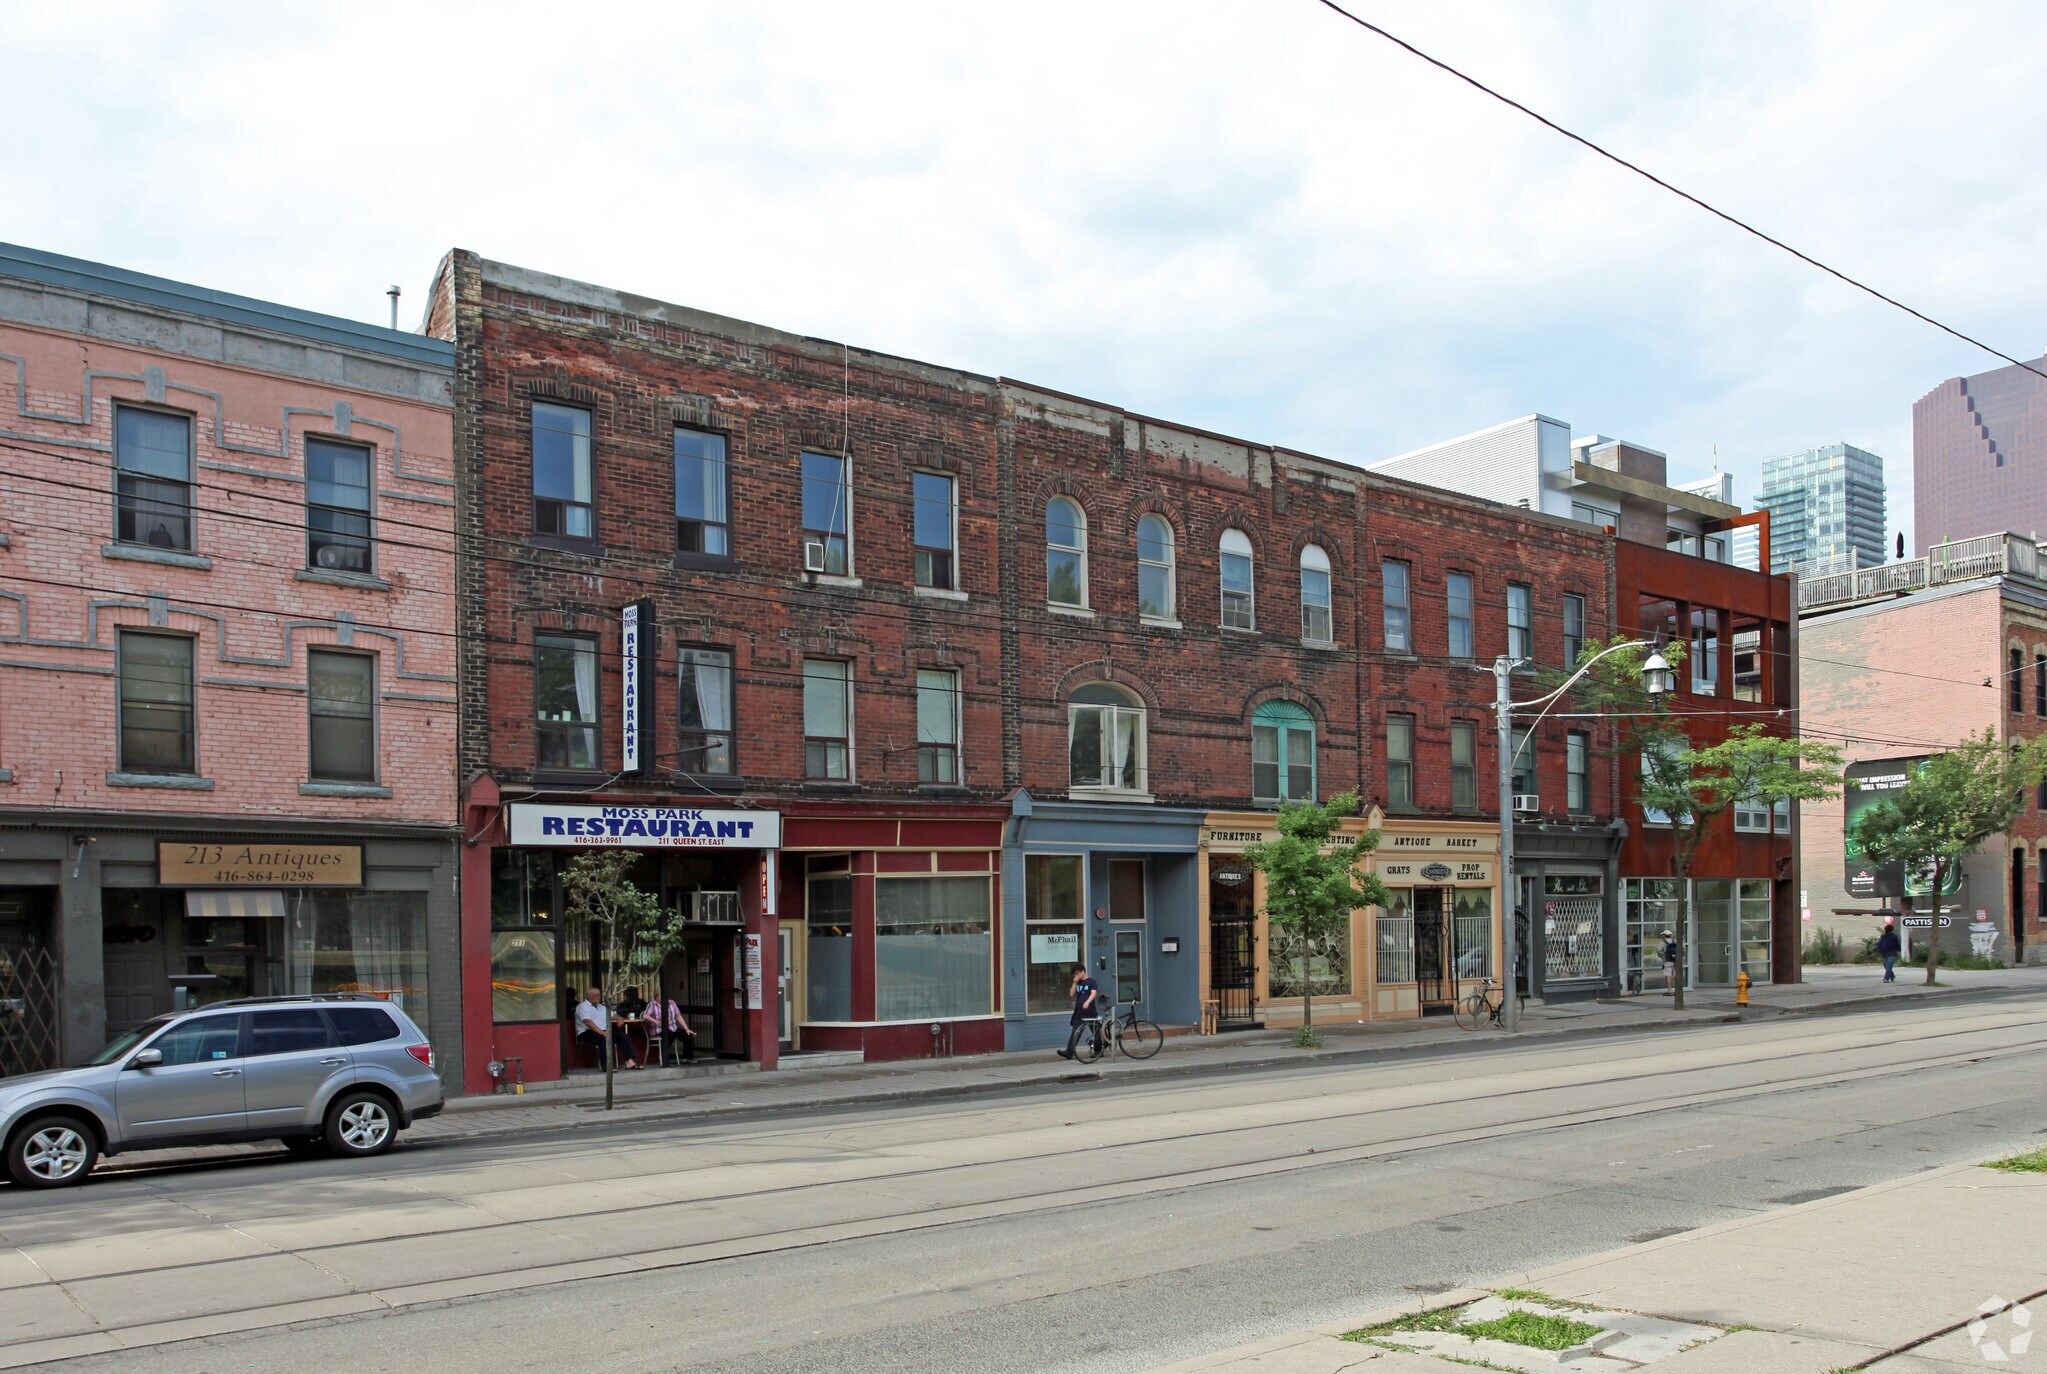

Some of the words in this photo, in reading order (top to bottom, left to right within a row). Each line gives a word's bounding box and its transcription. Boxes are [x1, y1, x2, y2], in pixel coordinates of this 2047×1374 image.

[624, 608, 637, 619] MOSS
[624, 617, 637, 629] PARK
[626, 632, 635, 760] RESTAURANT
[1869, 774, 1906, 783] IMPRESSION
[1860, 783, 1875, 791] WILL
[1876, 782, 1888, 790] YOU
[602, 807, 649, 819] MOSS
[655, 809, 704, 820] PARK
[542, 816, 754, 838] RESTAURANT
[1210, 831, 1262, 842] FURNITURE
[673, 838, 696, 846] QUEEN
[708, 838, 725, 846] EAST
[1394, 837, 1431, 847] ANTIQUE
[1446, 838, 1478, 847] MARKET
[184, 846, 223, 865] 213
[234, 846, 342, 870] Antiques
[1386, 866, 1411, 875] GRAYS
[1461, 863, 1480, 872] PROP
[214, 870, 315, 882] 416-864-0298
[1218, 872, 1242, 881] ANTIQUES
[1456, 872, 1485, 880] RENTALS
[1904, 917, 1948, 927] PATTISN
[511, 939, 526, 947] 211
[1047, 935, 1077, 944] McPhail
[1092, 935, 1109, 947] 207
